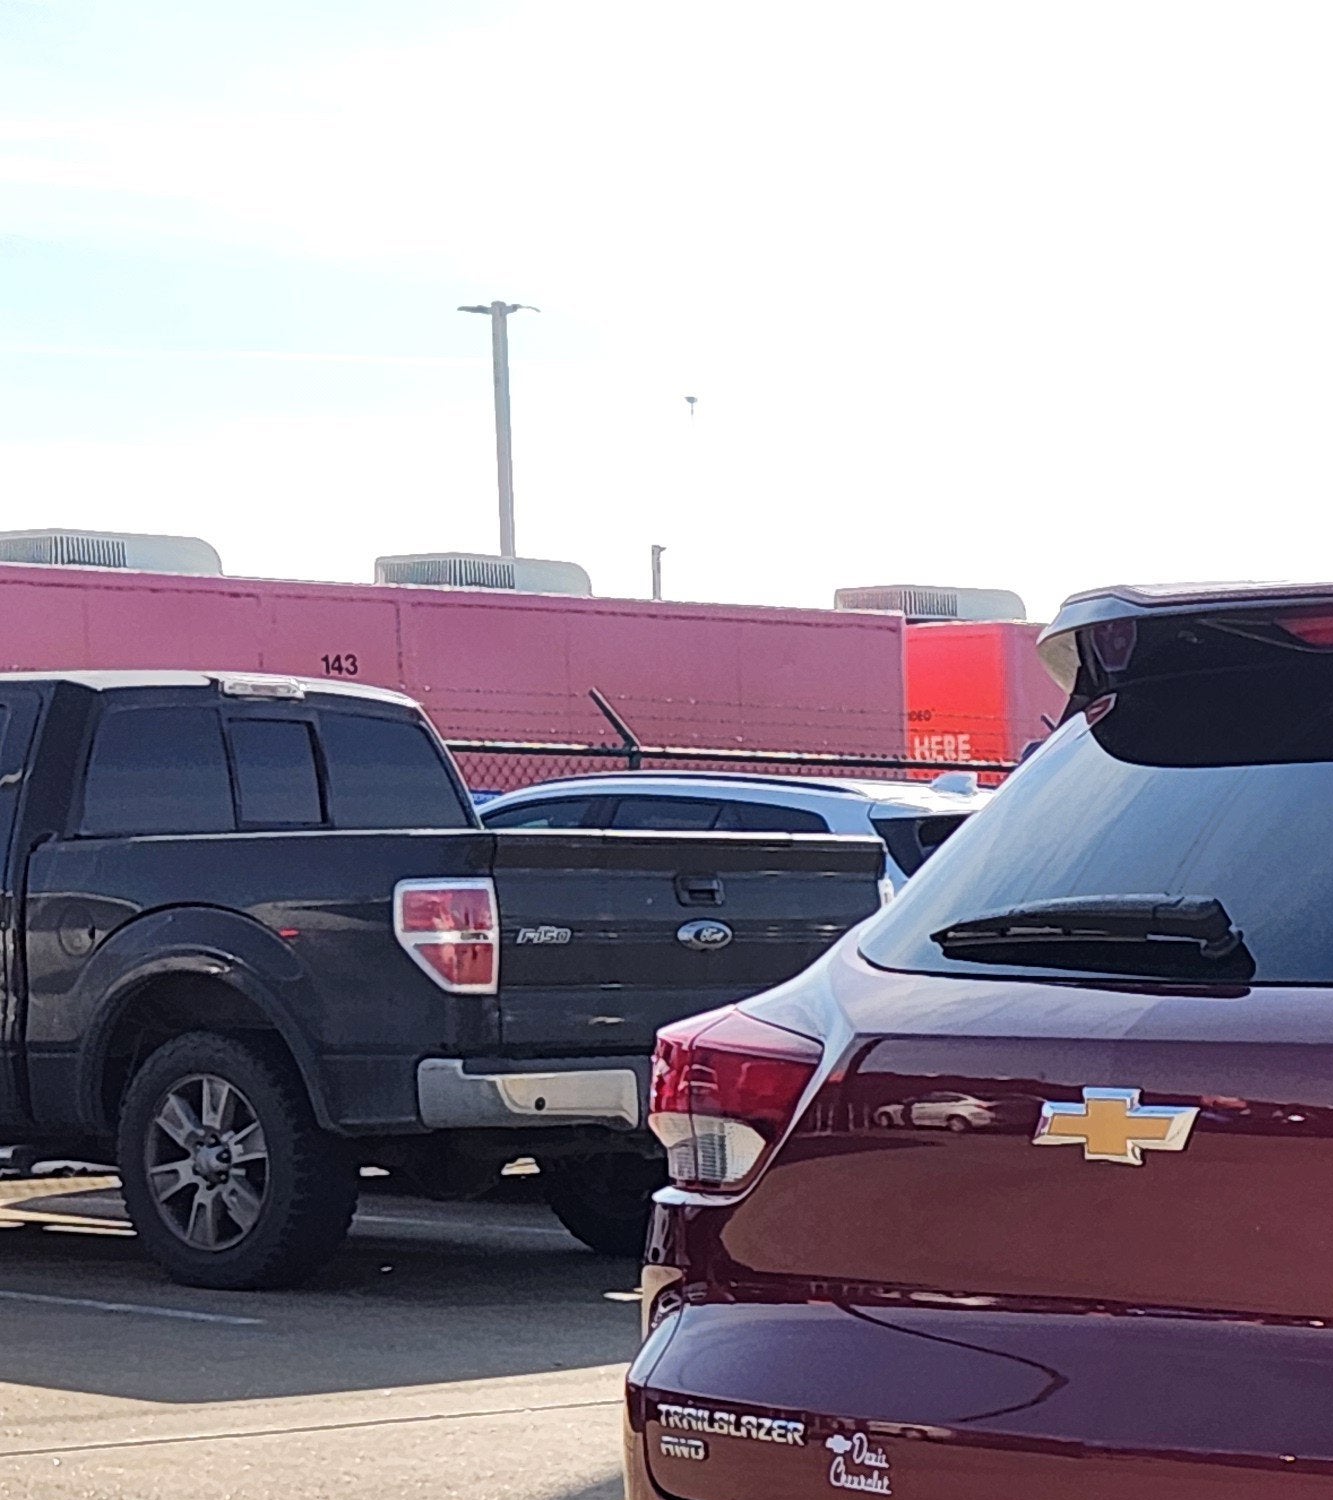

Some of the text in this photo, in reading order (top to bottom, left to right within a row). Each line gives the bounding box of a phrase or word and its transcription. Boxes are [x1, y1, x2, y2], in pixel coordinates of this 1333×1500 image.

[321, 653, 359, 676] 143
[914, 734, 971, 763] HERE
[656, 1403, 806, 1446] TRAILBLAZER
